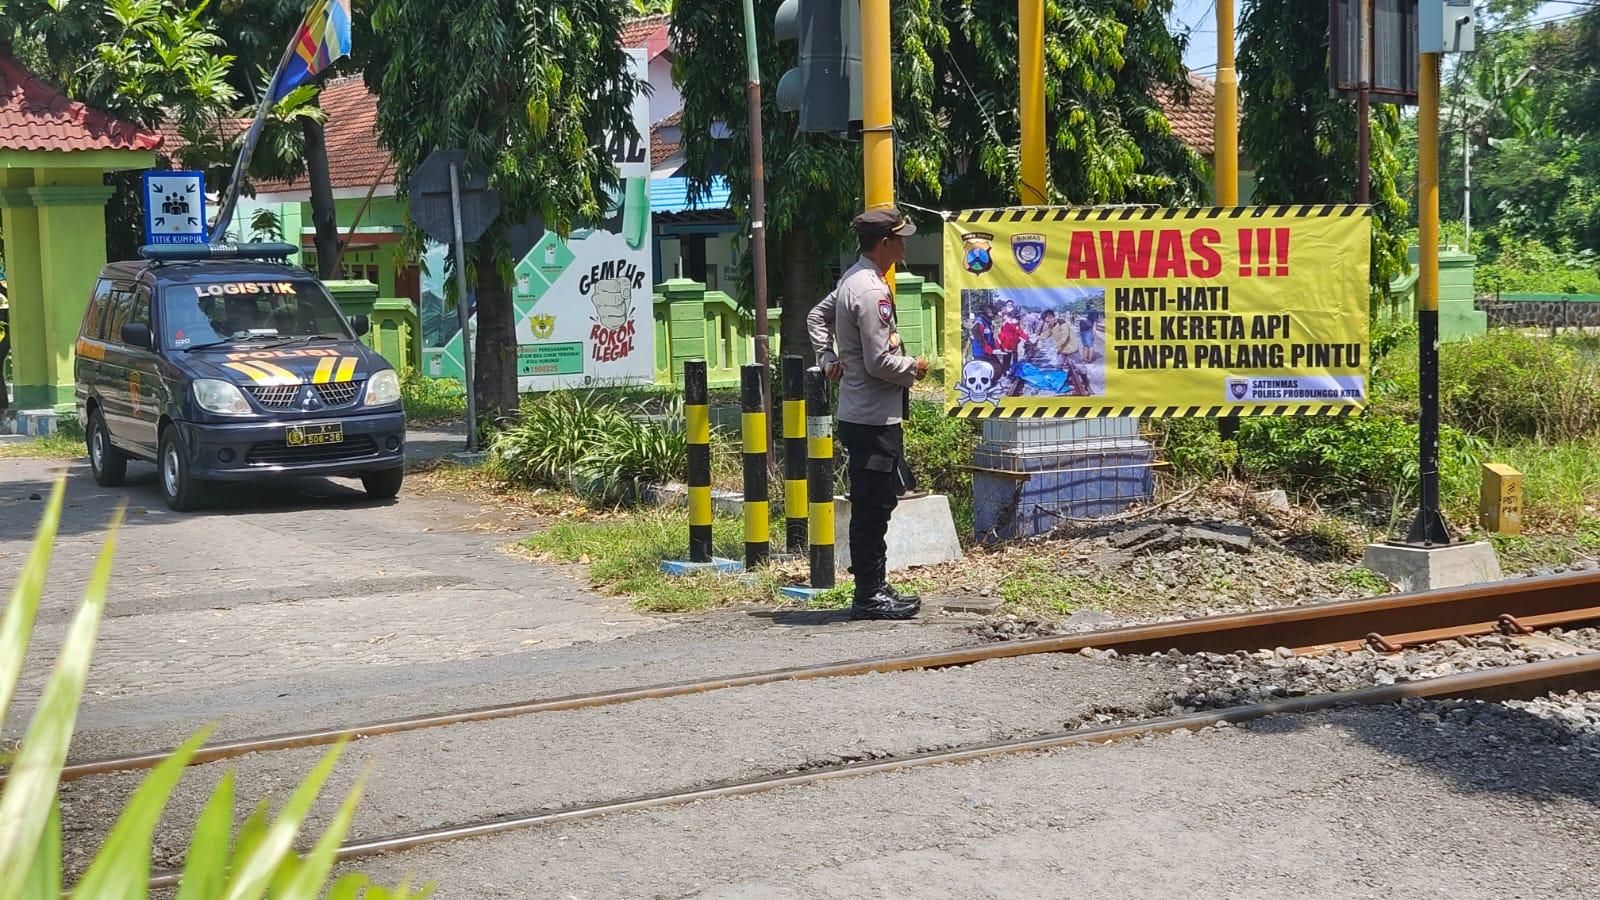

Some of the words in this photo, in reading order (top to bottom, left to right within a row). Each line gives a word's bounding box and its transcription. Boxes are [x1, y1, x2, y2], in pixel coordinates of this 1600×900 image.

[152, 235, 170, 244] TITIK
[173, 235, 203, 243] KUMPUL
[1066, 227, 1222, 279] AWAS
[1238, 227, 1290, 277] !!!
[579, 259, 645, 295] GEMPUR
[195, 282, 297, 298] LOGISTIK
[1114, 286, 1229, 311] HATI-HATI
[590, 319, 635, 346] ROKOK
[1114, 317, 1154, 341] REL
[1160, 315, 1245, 340] KERETA
[1251, 314, 1290, 339] API
[226, 350, 341, 361] POLISI
[592, 336, 634, 362] ILEGAL
[1114, 345, 1188, 369] TANPA
[1194, 344, 1284, 369] PALANG
[1291, 343, 1361, 368] PINTU
[1252, 380, 1298, 389] SATBINMAS
[1252, 389, 1282, 398] POLRES
[1283, 389, 1338, 398] PROBOLINGGO
